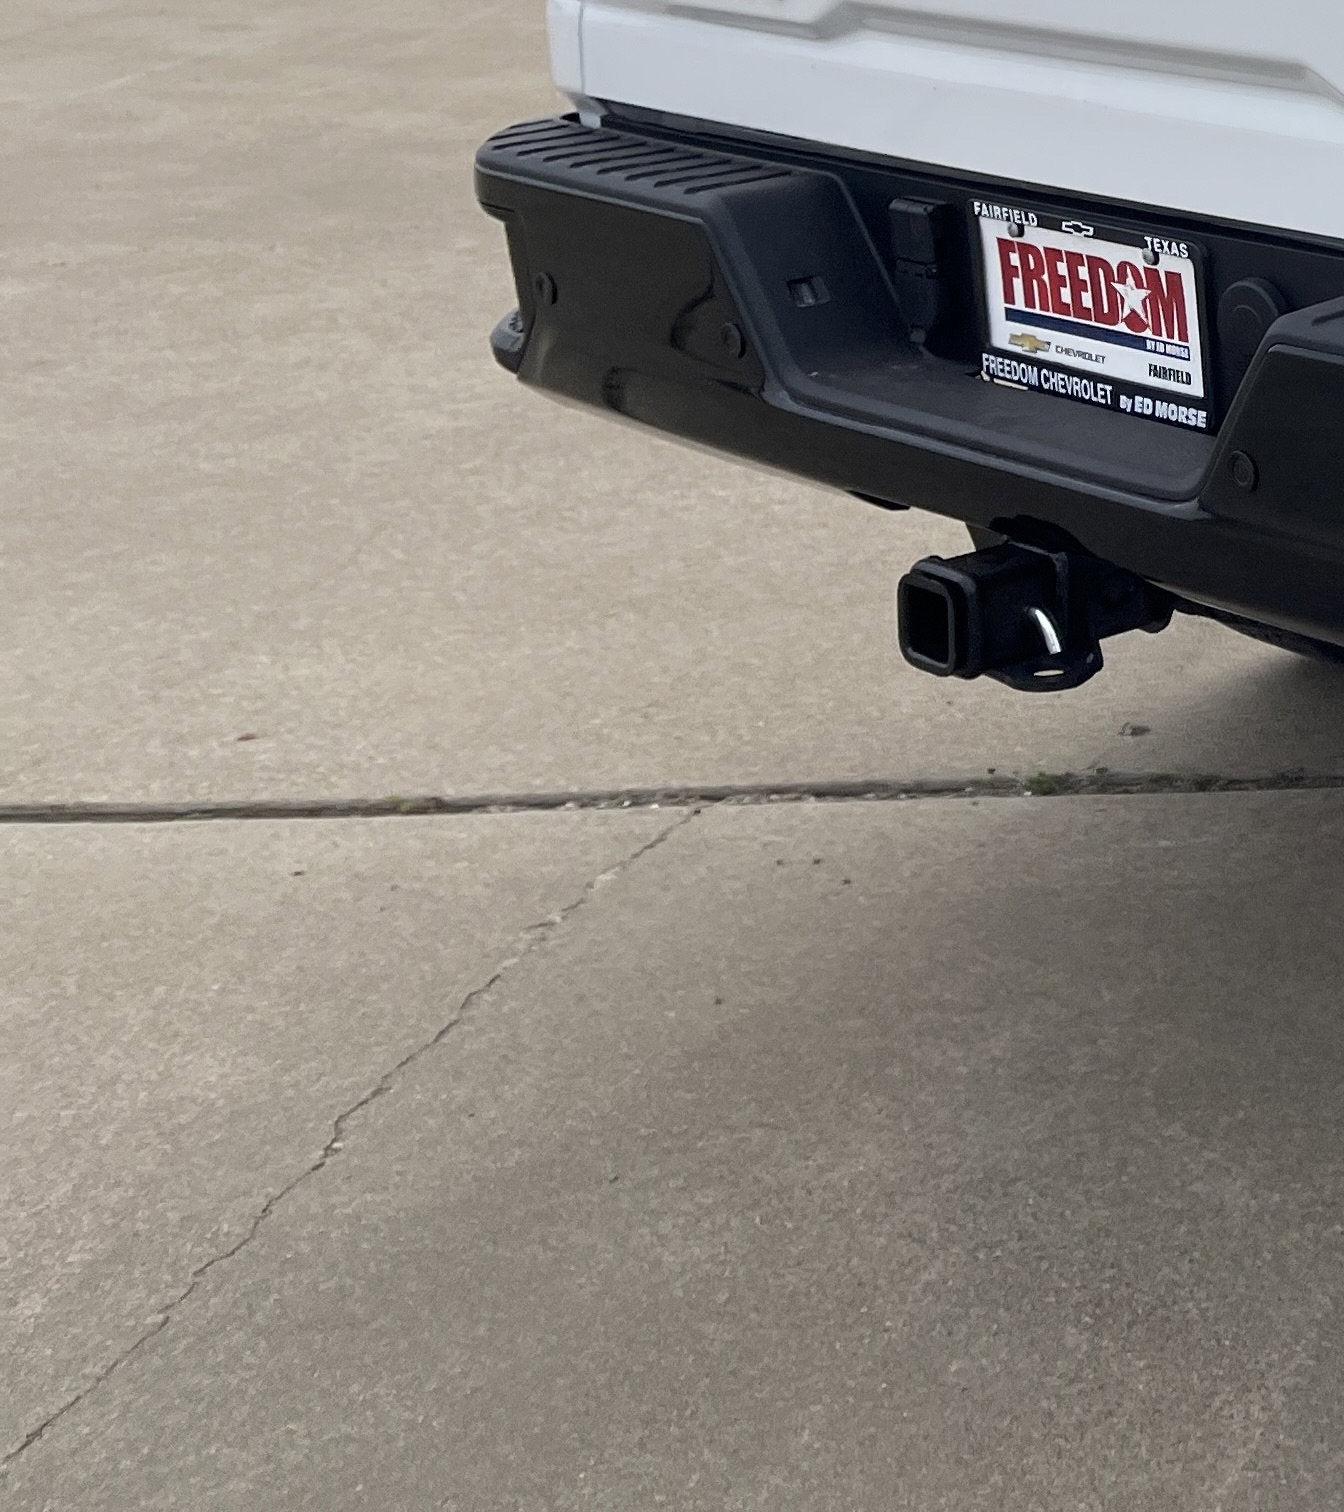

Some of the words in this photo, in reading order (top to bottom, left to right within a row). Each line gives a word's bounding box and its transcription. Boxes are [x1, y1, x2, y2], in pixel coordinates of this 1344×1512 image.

[973, 201, 1038, 227] FAIRFIELD
[1144, 236, 1189, 258] TEXAS
[995, 237, 1189, 343] FREEDOM
[1055, 345, 1106, 364] CHEVROLET
[1148, 363, 1192, 386] FAIRFIELD
[982, 353, 1039, 387] FREEDOM
[1040, 368, 1113, 405] CHEVROLET
[1134, 395, 1153, 415] ED
[1154, 399, 1207, 429] MORSE
